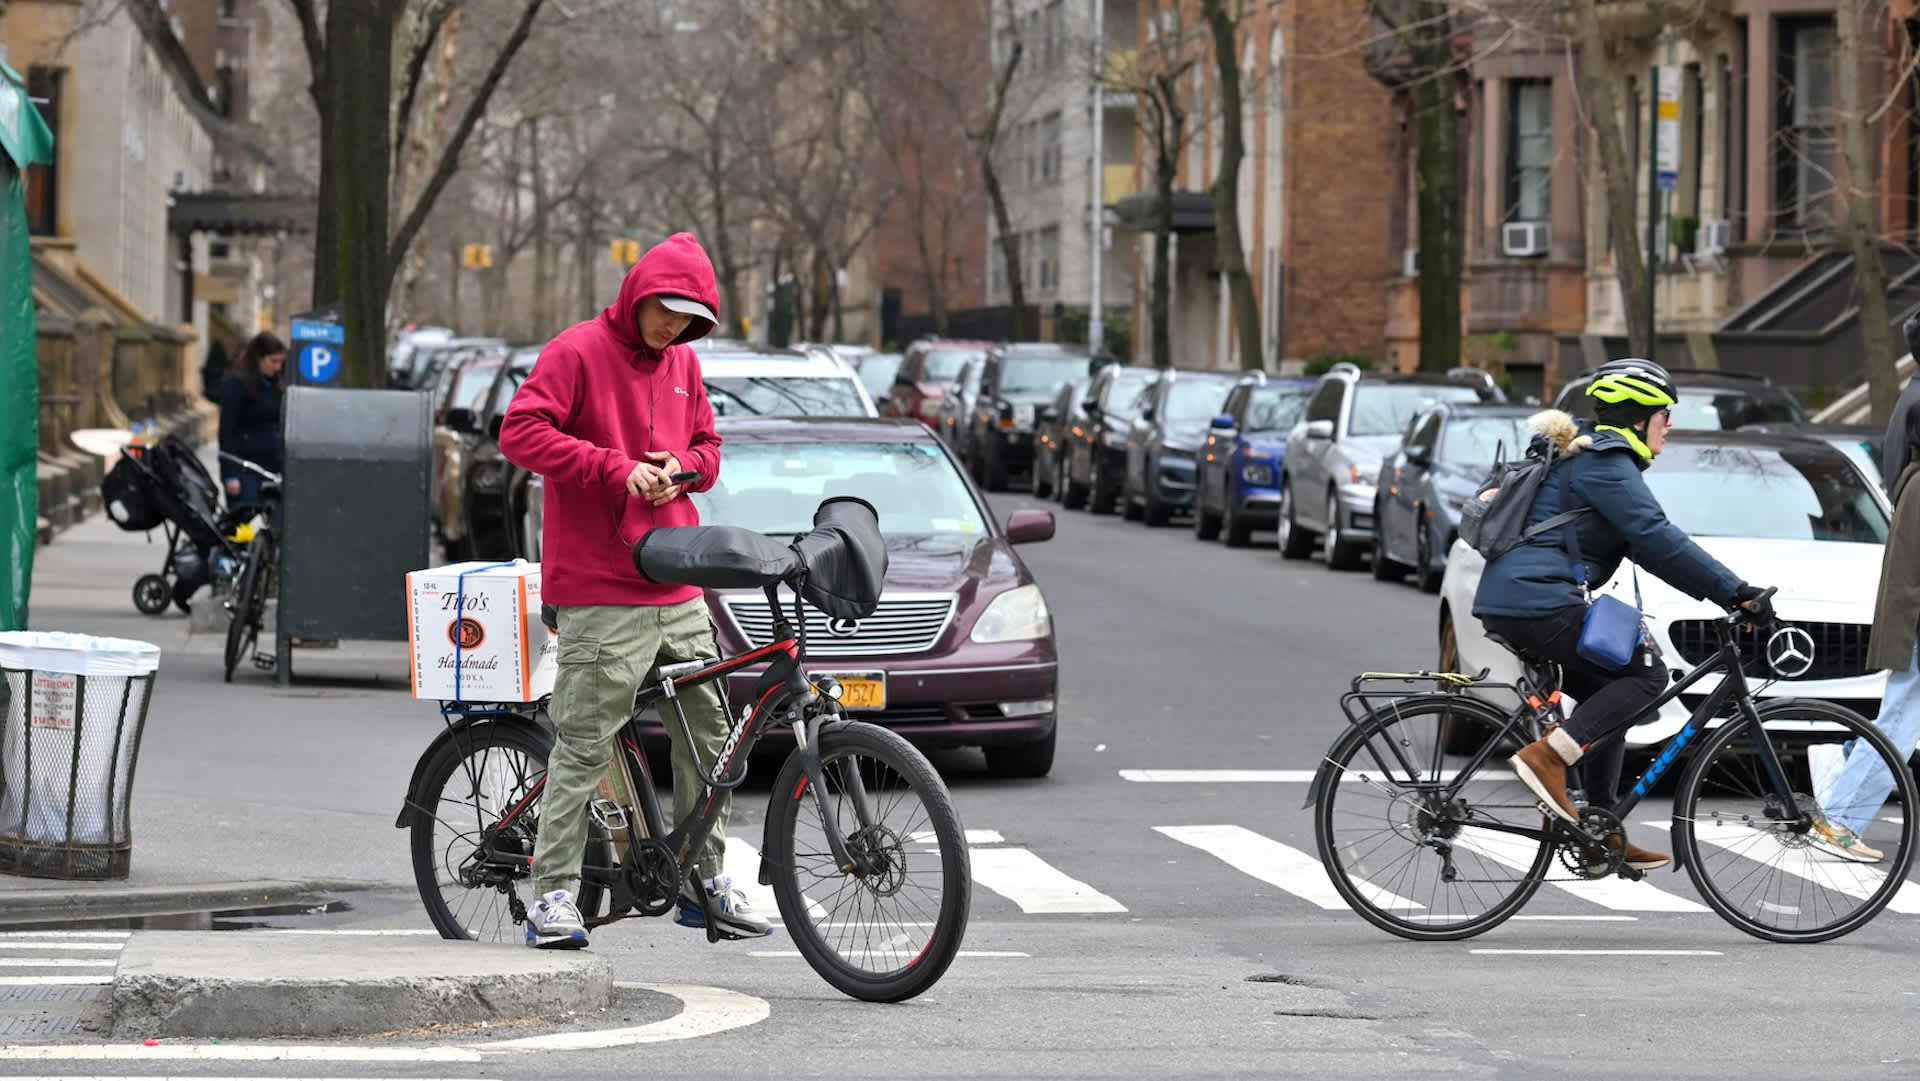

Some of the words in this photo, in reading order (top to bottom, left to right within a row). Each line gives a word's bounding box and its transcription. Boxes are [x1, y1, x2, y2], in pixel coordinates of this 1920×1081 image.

[312, 347, 332, 377] P
[441, 592, 489, 611] Tito's
[438, 653, 498, 670] Hadmade
[1632, 723, 1696, 796] TREK
